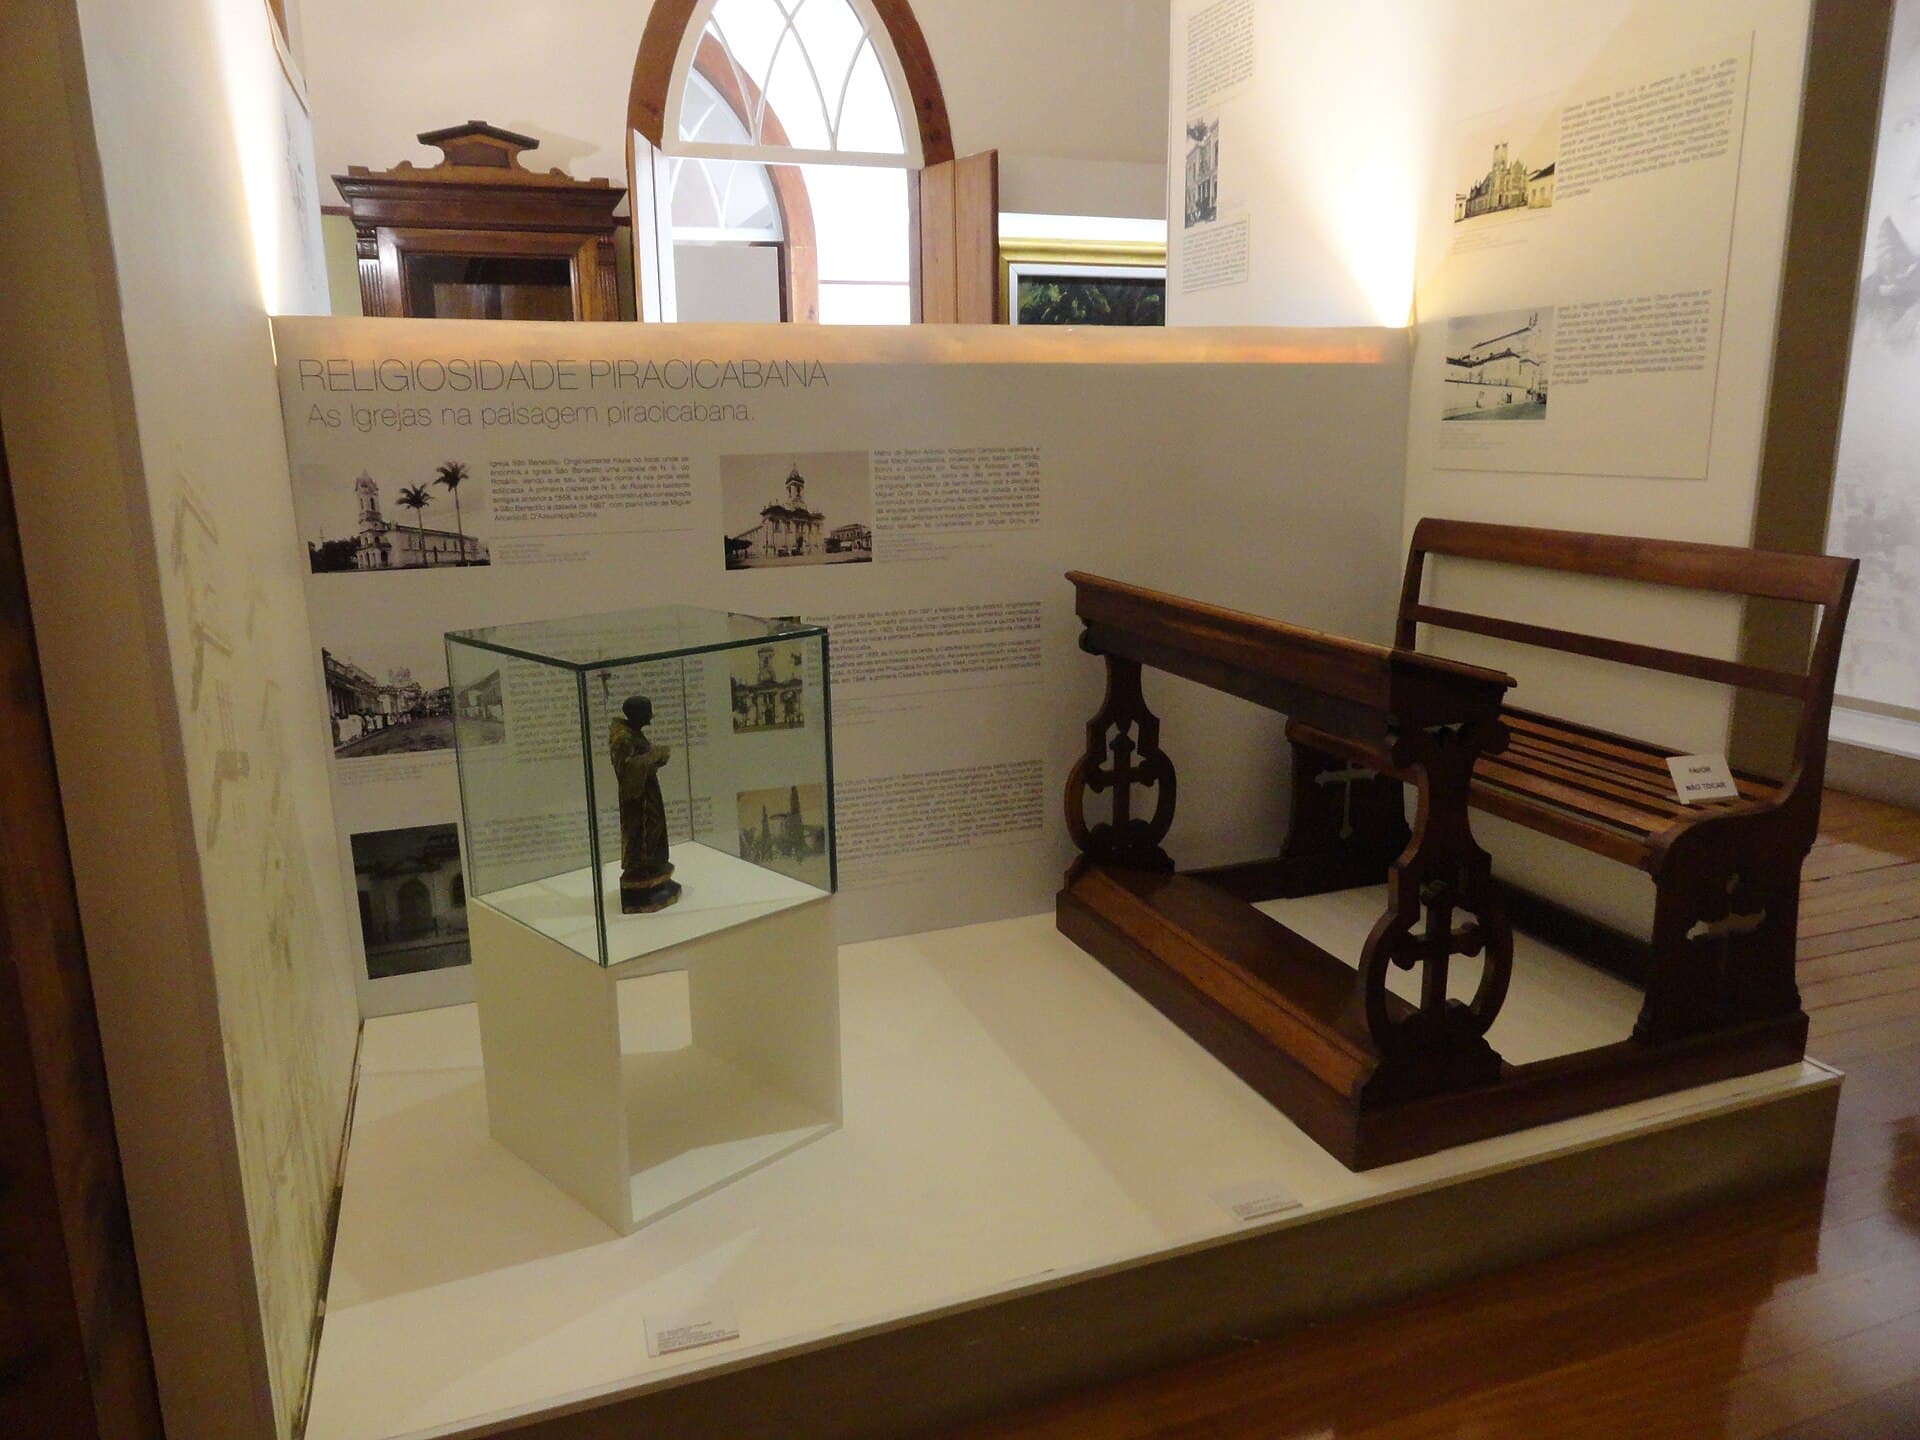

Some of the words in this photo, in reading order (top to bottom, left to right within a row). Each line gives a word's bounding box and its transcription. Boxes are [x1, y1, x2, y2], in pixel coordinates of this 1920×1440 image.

[298, 358, 579, 392] RELIGIOSIDADE
[589, 358, 830, 391] PIRACICABANA
[307, 403, 342, 428] As
[351, 403, 432, 432] Igrejas
[442, 407, 472, 426] na
[482, 402, 598, 430] paisagem
[607, 399, 755, 428] piracicabana.
